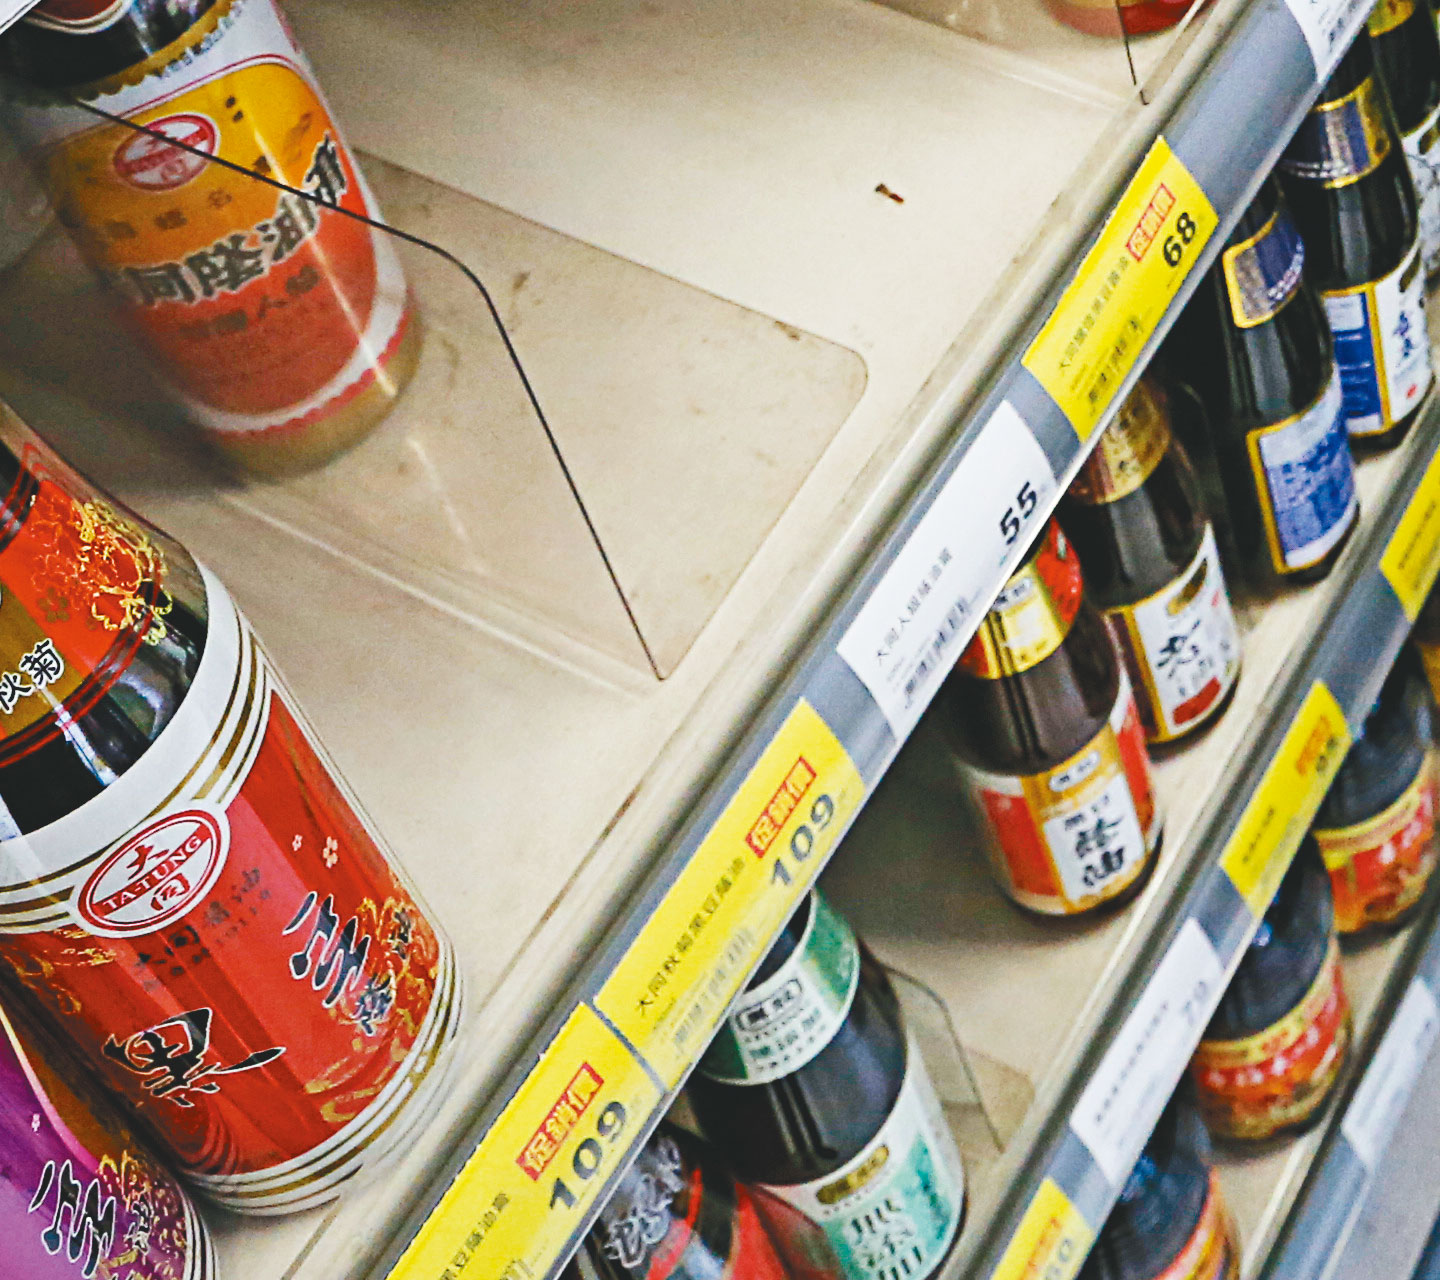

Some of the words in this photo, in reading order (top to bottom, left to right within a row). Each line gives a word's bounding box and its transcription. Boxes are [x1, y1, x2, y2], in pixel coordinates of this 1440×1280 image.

[1162, 211, 1197, 268] 68
[999, 480, 1038, 547] 55
[102, 834, 202, 912] TA-TUNG
[125, 841, 171, 881] 大
[770, 794, 835, 887] 109
[149, 875, 192, 912] 同
[549, 1100, 627, 1211] 109
